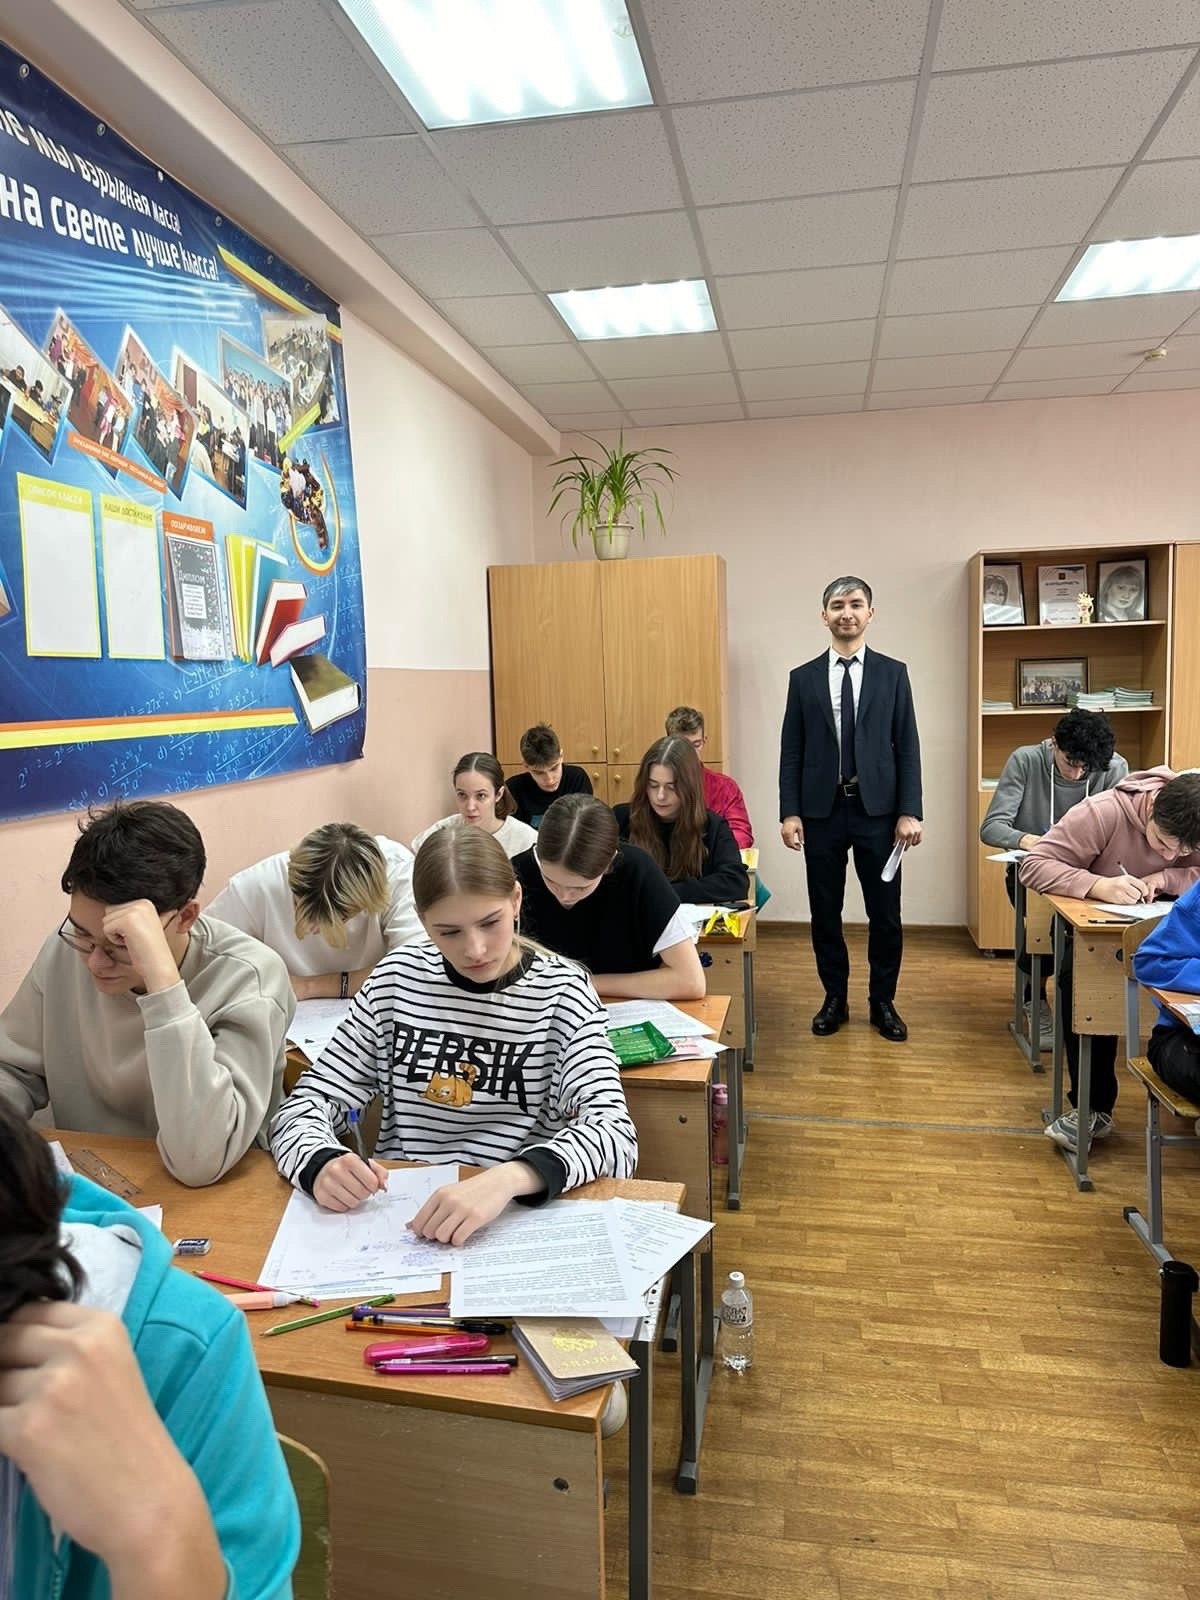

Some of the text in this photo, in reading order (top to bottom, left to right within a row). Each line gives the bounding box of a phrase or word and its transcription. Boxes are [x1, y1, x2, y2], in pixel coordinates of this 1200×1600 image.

[28, 124, 76, 173] мы
[72, 151, 152, 217] взрывная
[0, 172, 220, 280] на свете лучше класса!
[391, 1021, 537, 1113] PERSIK
